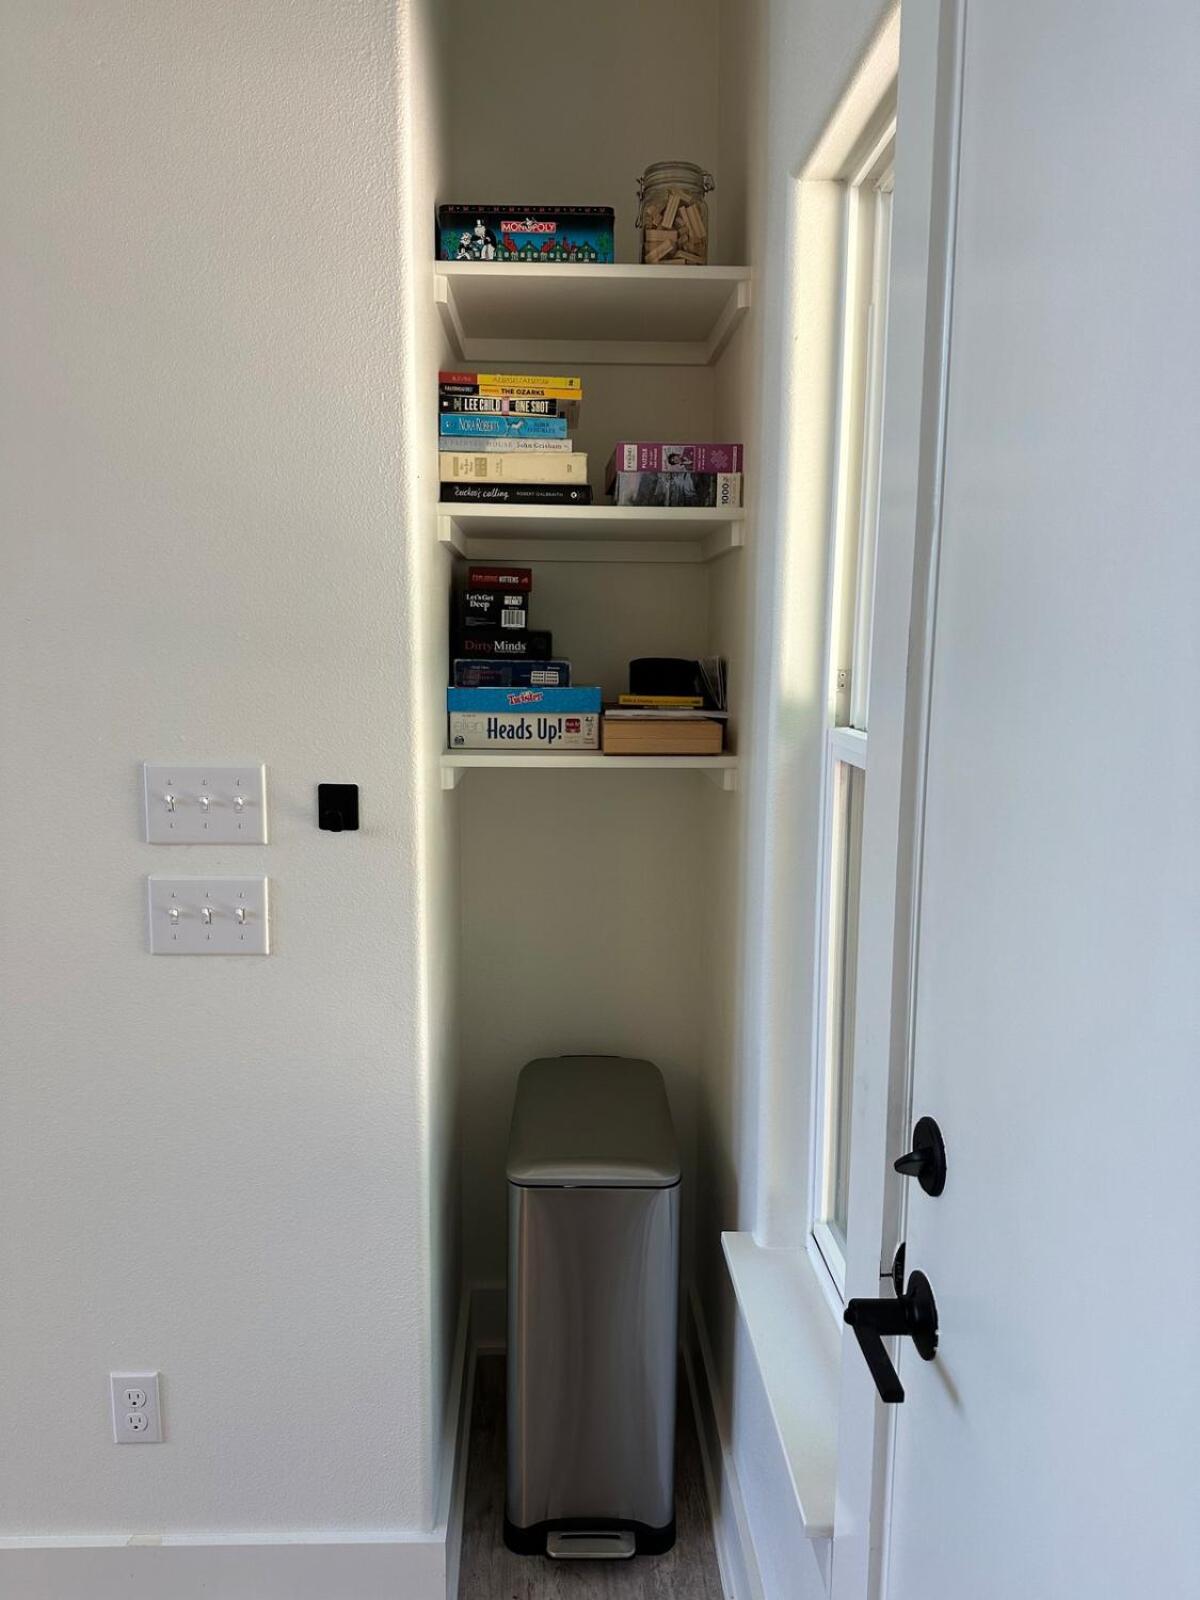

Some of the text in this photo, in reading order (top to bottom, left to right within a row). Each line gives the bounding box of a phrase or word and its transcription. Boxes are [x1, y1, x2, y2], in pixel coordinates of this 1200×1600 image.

[502, 222, 555, 232] MONOPOLY
[501, 387, 514, 395] THE
[516, 388, 545, 397] OZARKS
[464, 398, 478, 411] LEE
[479, 398, 501, 412] CHILD
[514, 400, 530, 412] ONE
[531, 401, 549, 414] SHOT
[516, 440, 532, 449] John
[533, 441, 562, 450] Grisham
[721, 483, 730, 504] 1000
[466, 593, 482, 601] Let's
[469, 600, 490, 612] Deep
[464, 640, 527, 652] Dirty Minds
[486, 717, 533, 740] Heads
[537, 717, 562, 744] Up!
